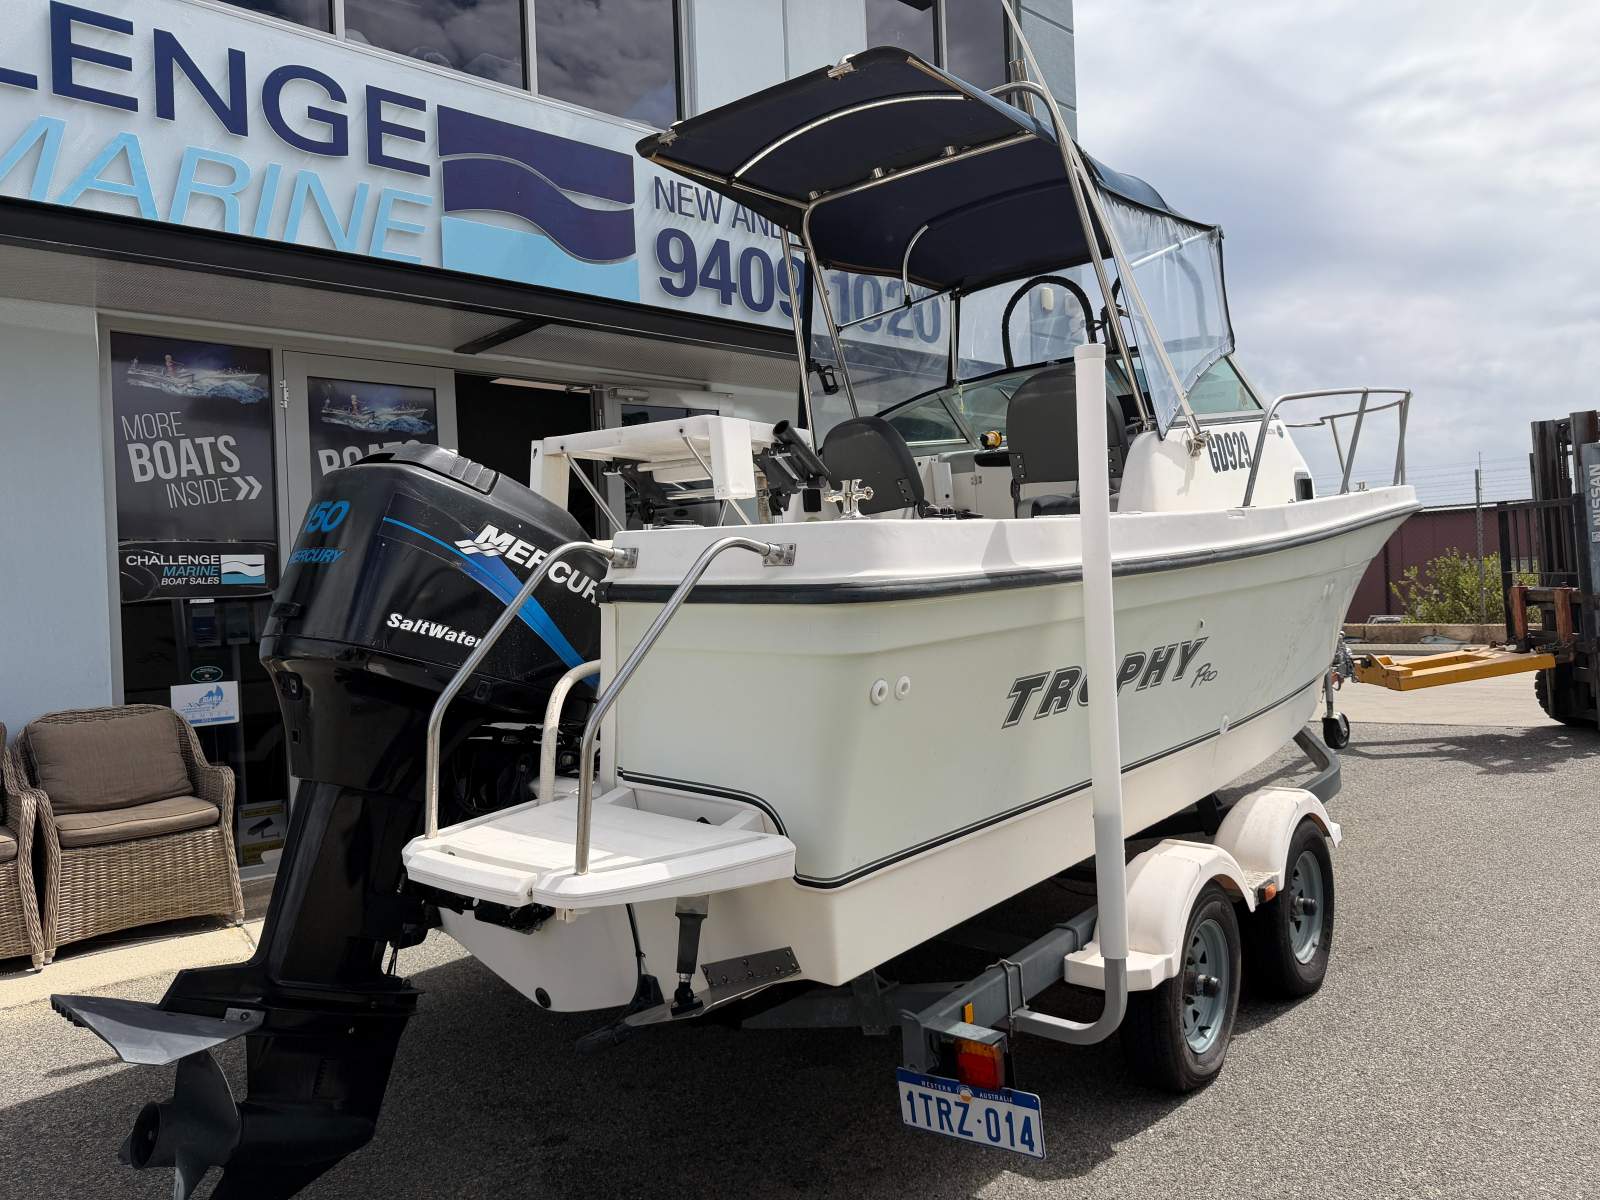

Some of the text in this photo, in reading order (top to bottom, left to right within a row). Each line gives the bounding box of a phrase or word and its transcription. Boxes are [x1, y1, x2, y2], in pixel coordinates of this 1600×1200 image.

[654, 176, 722, 224] NEW
[656, 228, 942, 344] 9409 1020
[121, 411, 186, 441] MORE
[127, 435, 241, 483] BOATS
[1206, 431, 1253, 474] GD929
[166, 477, 232, 508] INSIDE
[126, 554, 220, 566] CHALLENGE
[163, 566, 219, 577] MARINE
[474, 523, 600, 606] MERCUR
[161, 576, 220, 586] BOAT SALES
[920, 1080, 1013, 1103] WESTERN AUSTRALIA
